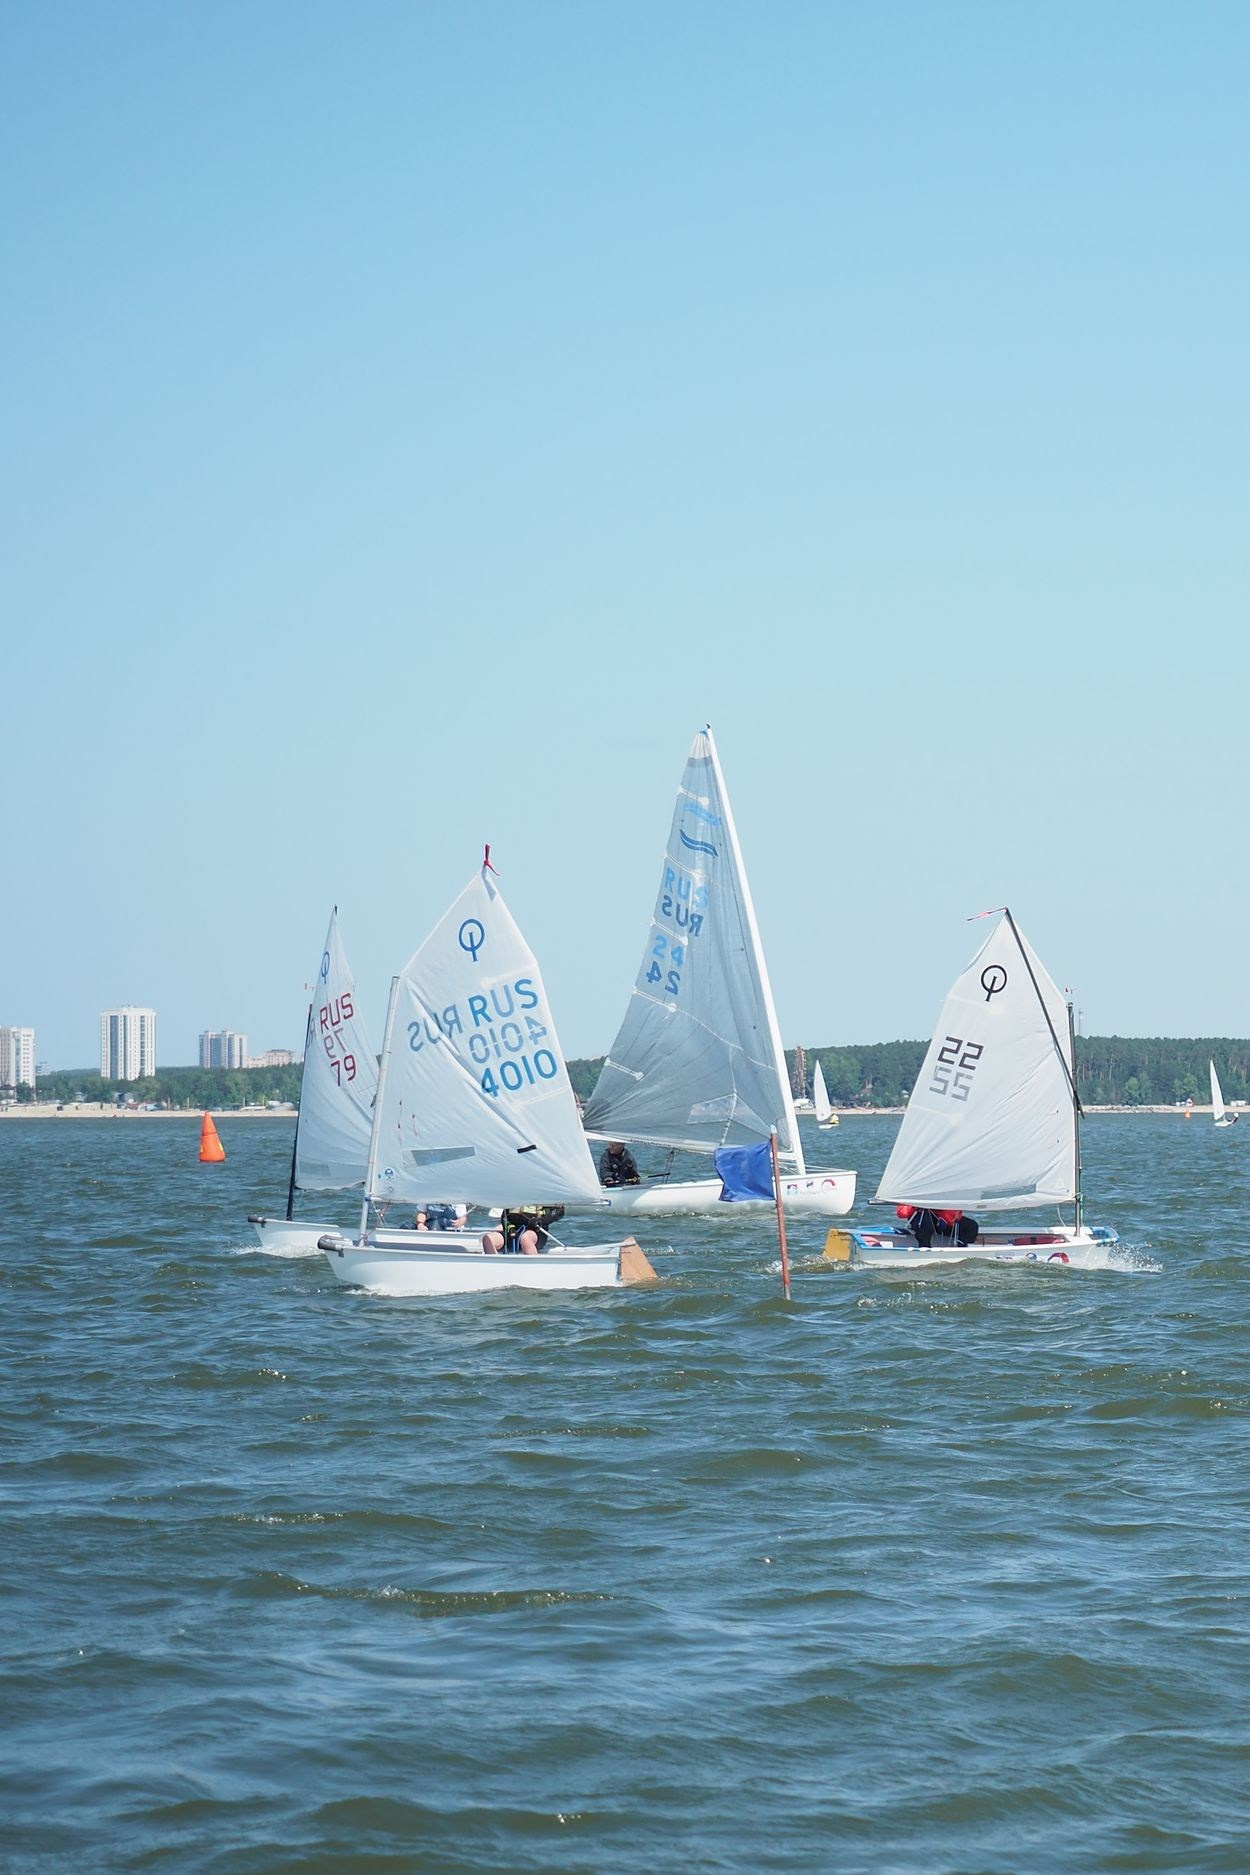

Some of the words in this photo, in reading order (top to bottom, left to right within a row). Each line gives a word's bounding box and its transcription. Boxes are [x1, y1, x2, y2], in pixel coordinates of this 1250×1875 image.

[320, 992, 354, 1034] RUS
[468, 978, 539, 1027] RUS
[330, 1054, 357, 1087] 79
[481, 1049, 558, 1098] 4010
